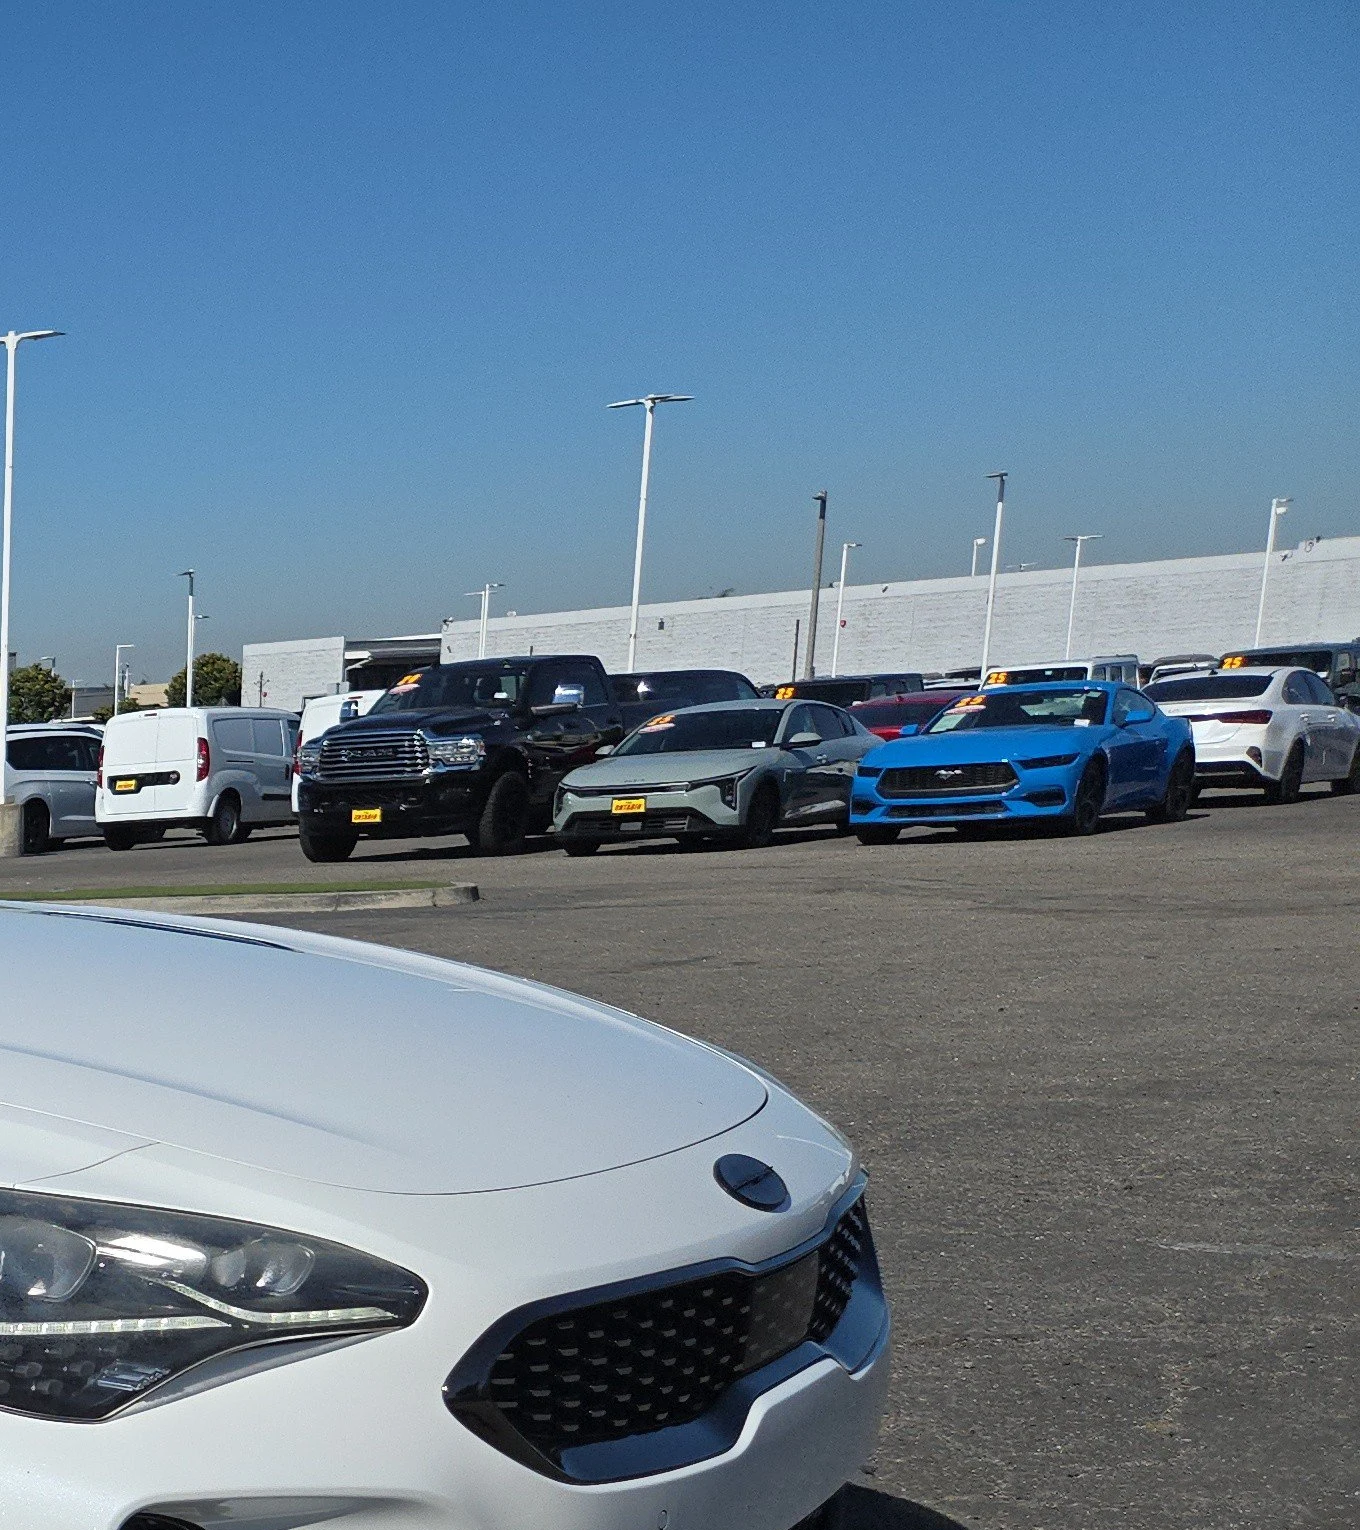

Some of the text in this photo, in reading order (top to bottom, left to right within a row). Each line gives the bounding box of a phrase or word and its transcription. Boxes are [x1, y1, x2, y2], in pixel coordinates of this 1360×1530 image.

[1222, 656, 1243, 669] 25
[986, 672, 1007, 684] 25
[775, 687, 795, 700] 25
